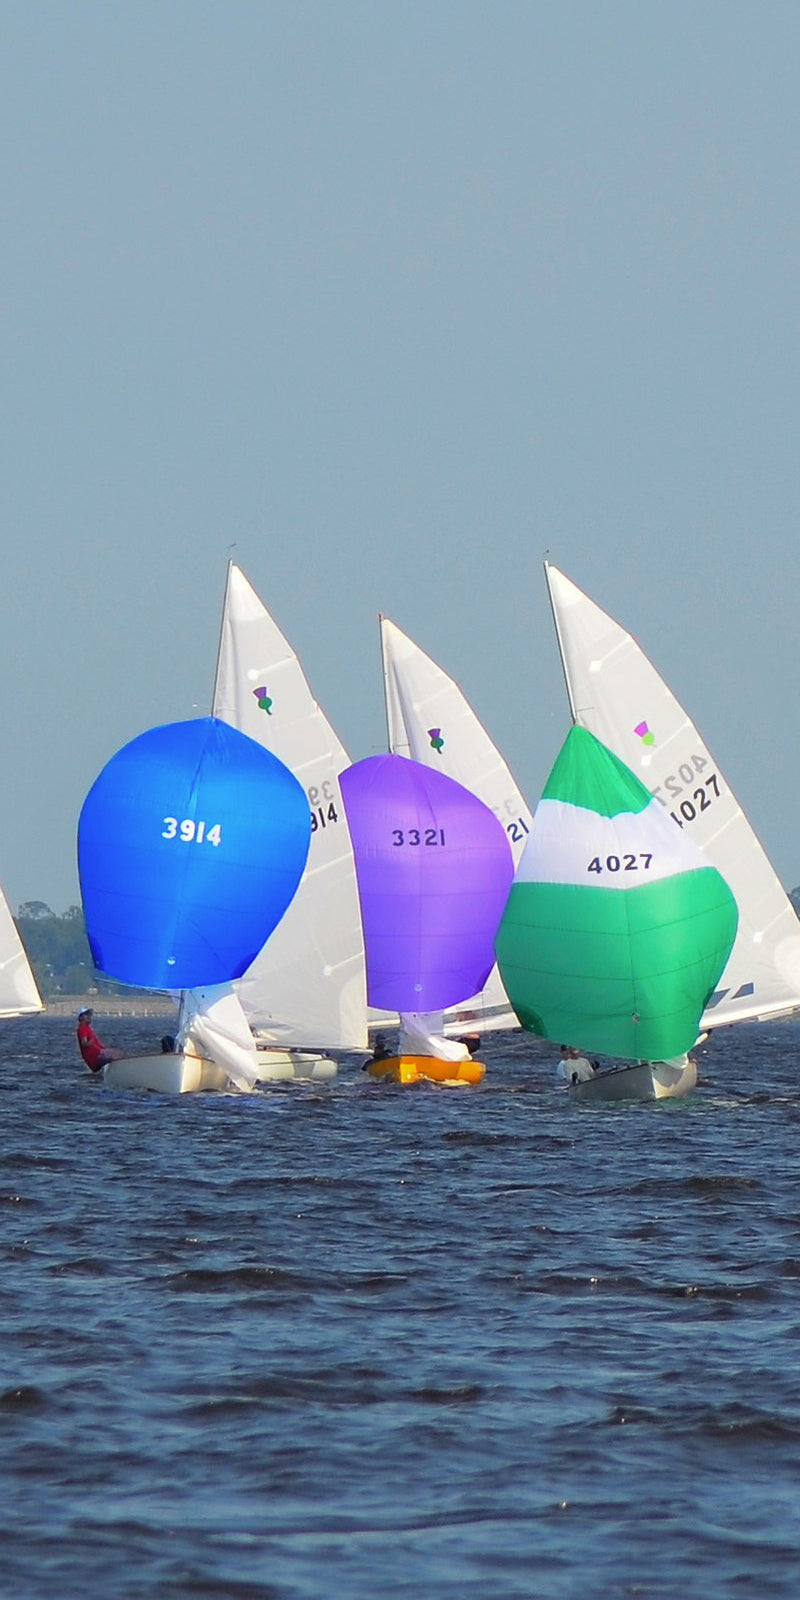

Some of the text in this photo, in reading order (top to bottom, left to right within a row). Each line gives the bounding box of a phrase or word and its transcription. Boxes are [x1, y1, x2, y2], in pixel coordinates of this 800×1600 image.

[161, 816, 222, 847] 3914
[392, 828, 446, 846] 3321
[587, 853, 653, 874] 4027
